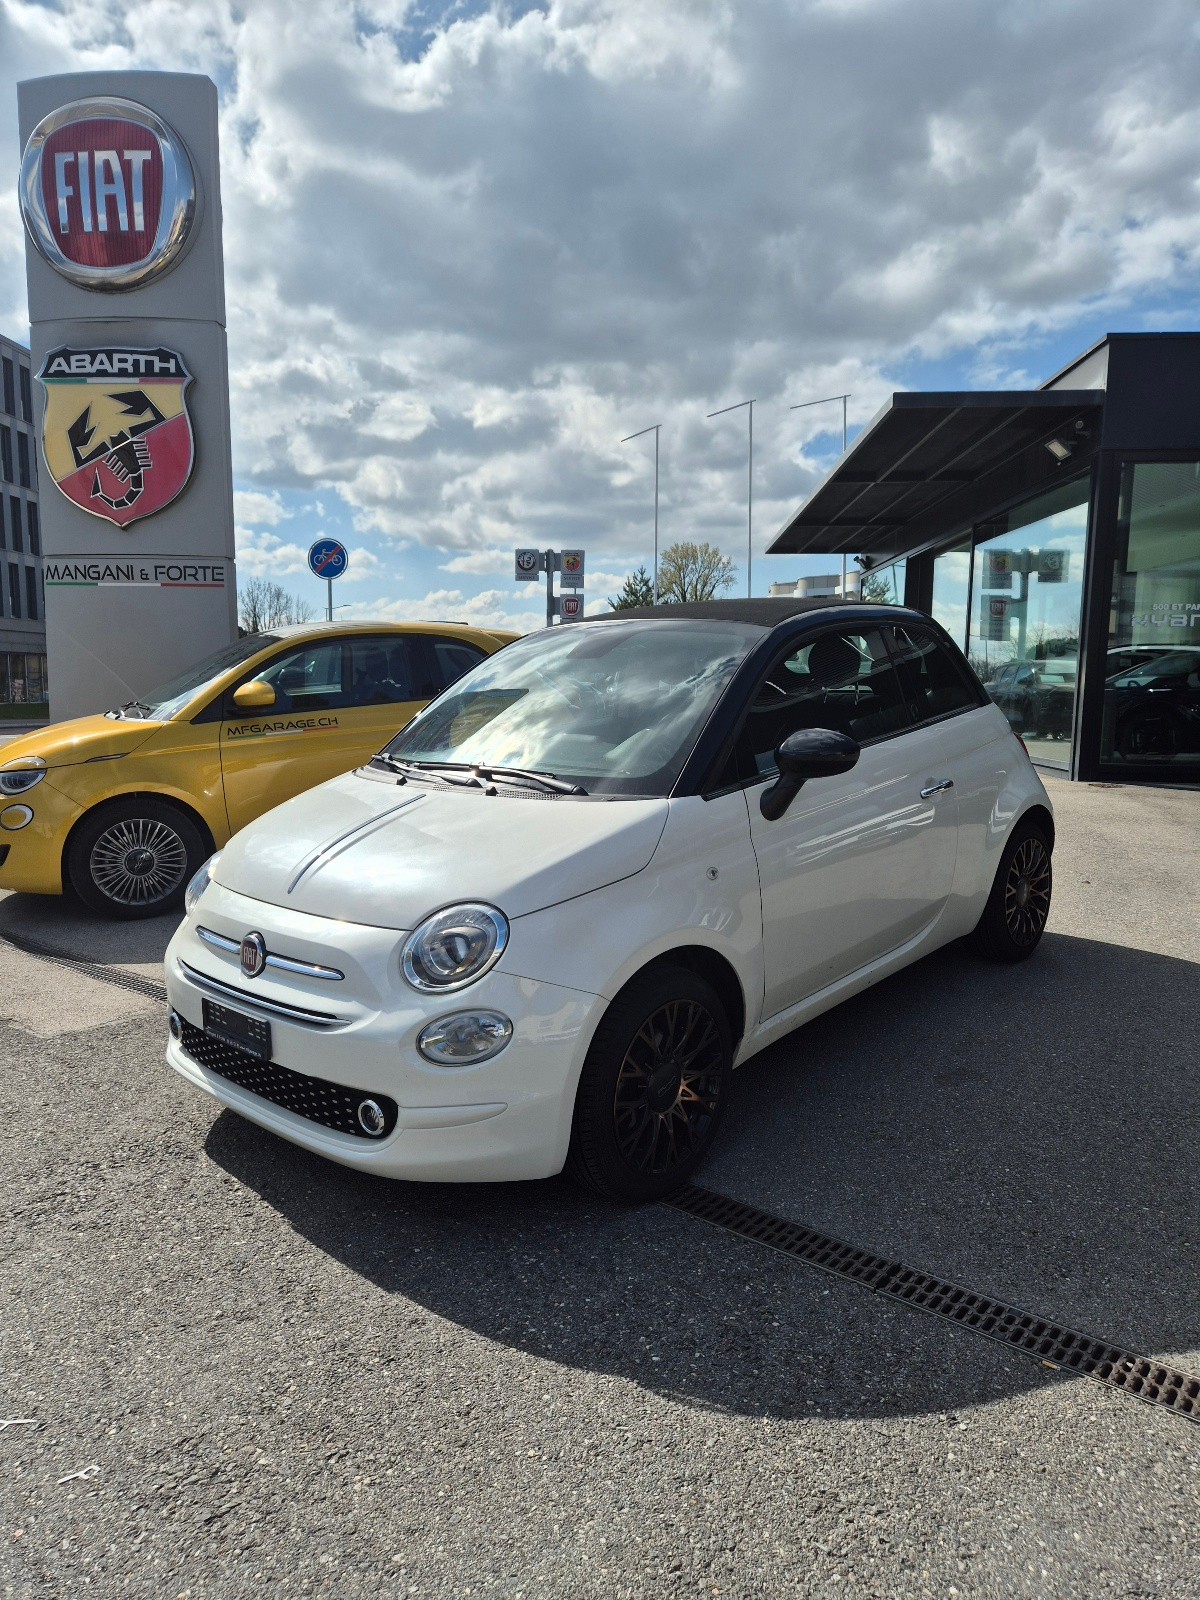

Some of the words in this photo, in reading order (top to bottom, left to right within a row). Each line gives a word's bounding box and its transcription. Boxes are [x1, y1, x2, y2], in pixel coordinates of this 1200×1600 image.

[54, 150, 151, 233] FIAT
[48, 353, 176, 374] ABARTH
[46, 565, 134, 581] MANGANI
[140, 568, 149, 581] &
[155, 566, 224, 582] FORTE
[566, 601, 578, 611] FIAT
[227, 717, 339, 736] MFGARAGE.CH
[243, 946, 257, 966] FIAT
